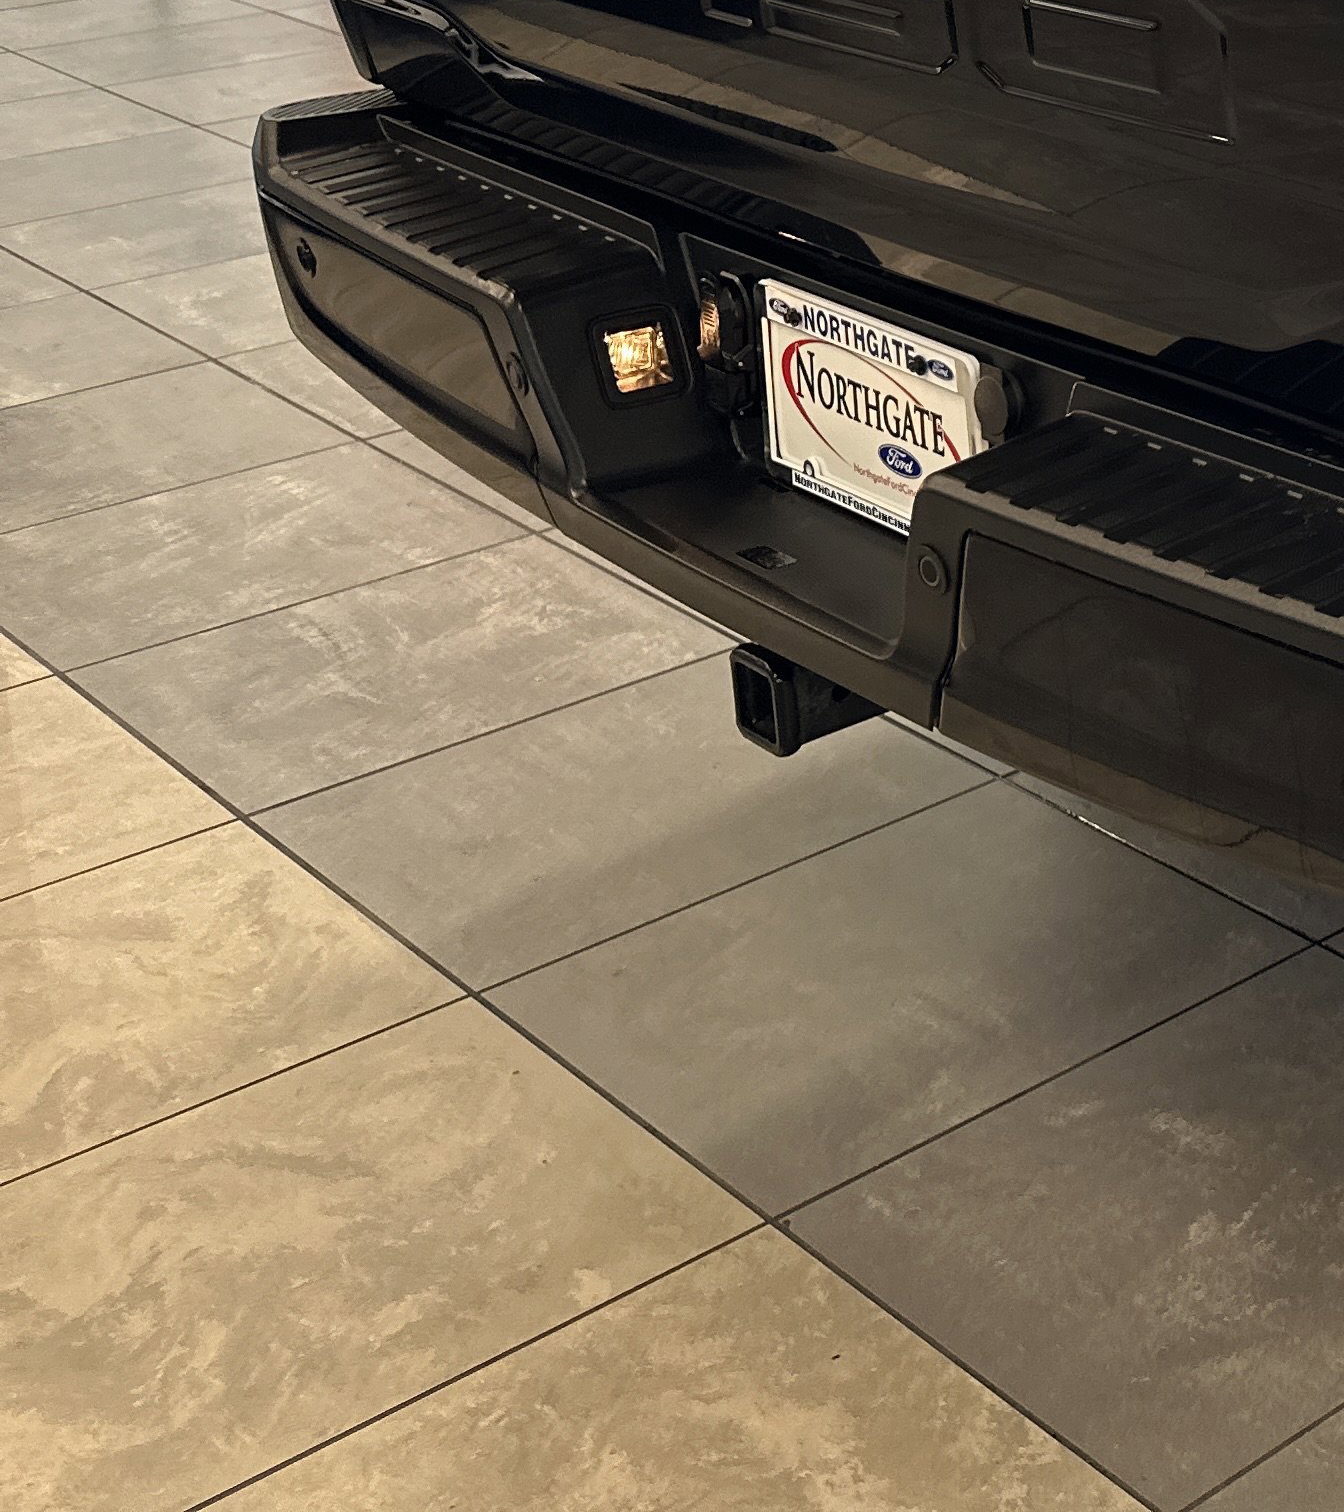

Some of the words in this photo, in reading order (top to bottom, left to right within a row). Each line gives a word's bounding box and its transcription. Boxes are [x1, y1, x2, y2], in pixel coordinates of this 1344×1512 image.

[803, 304, 914, 369] NORTHGATE
[795, 345, 946, 457] NORTHGATE
[887, 445, 914, 475] Ford
